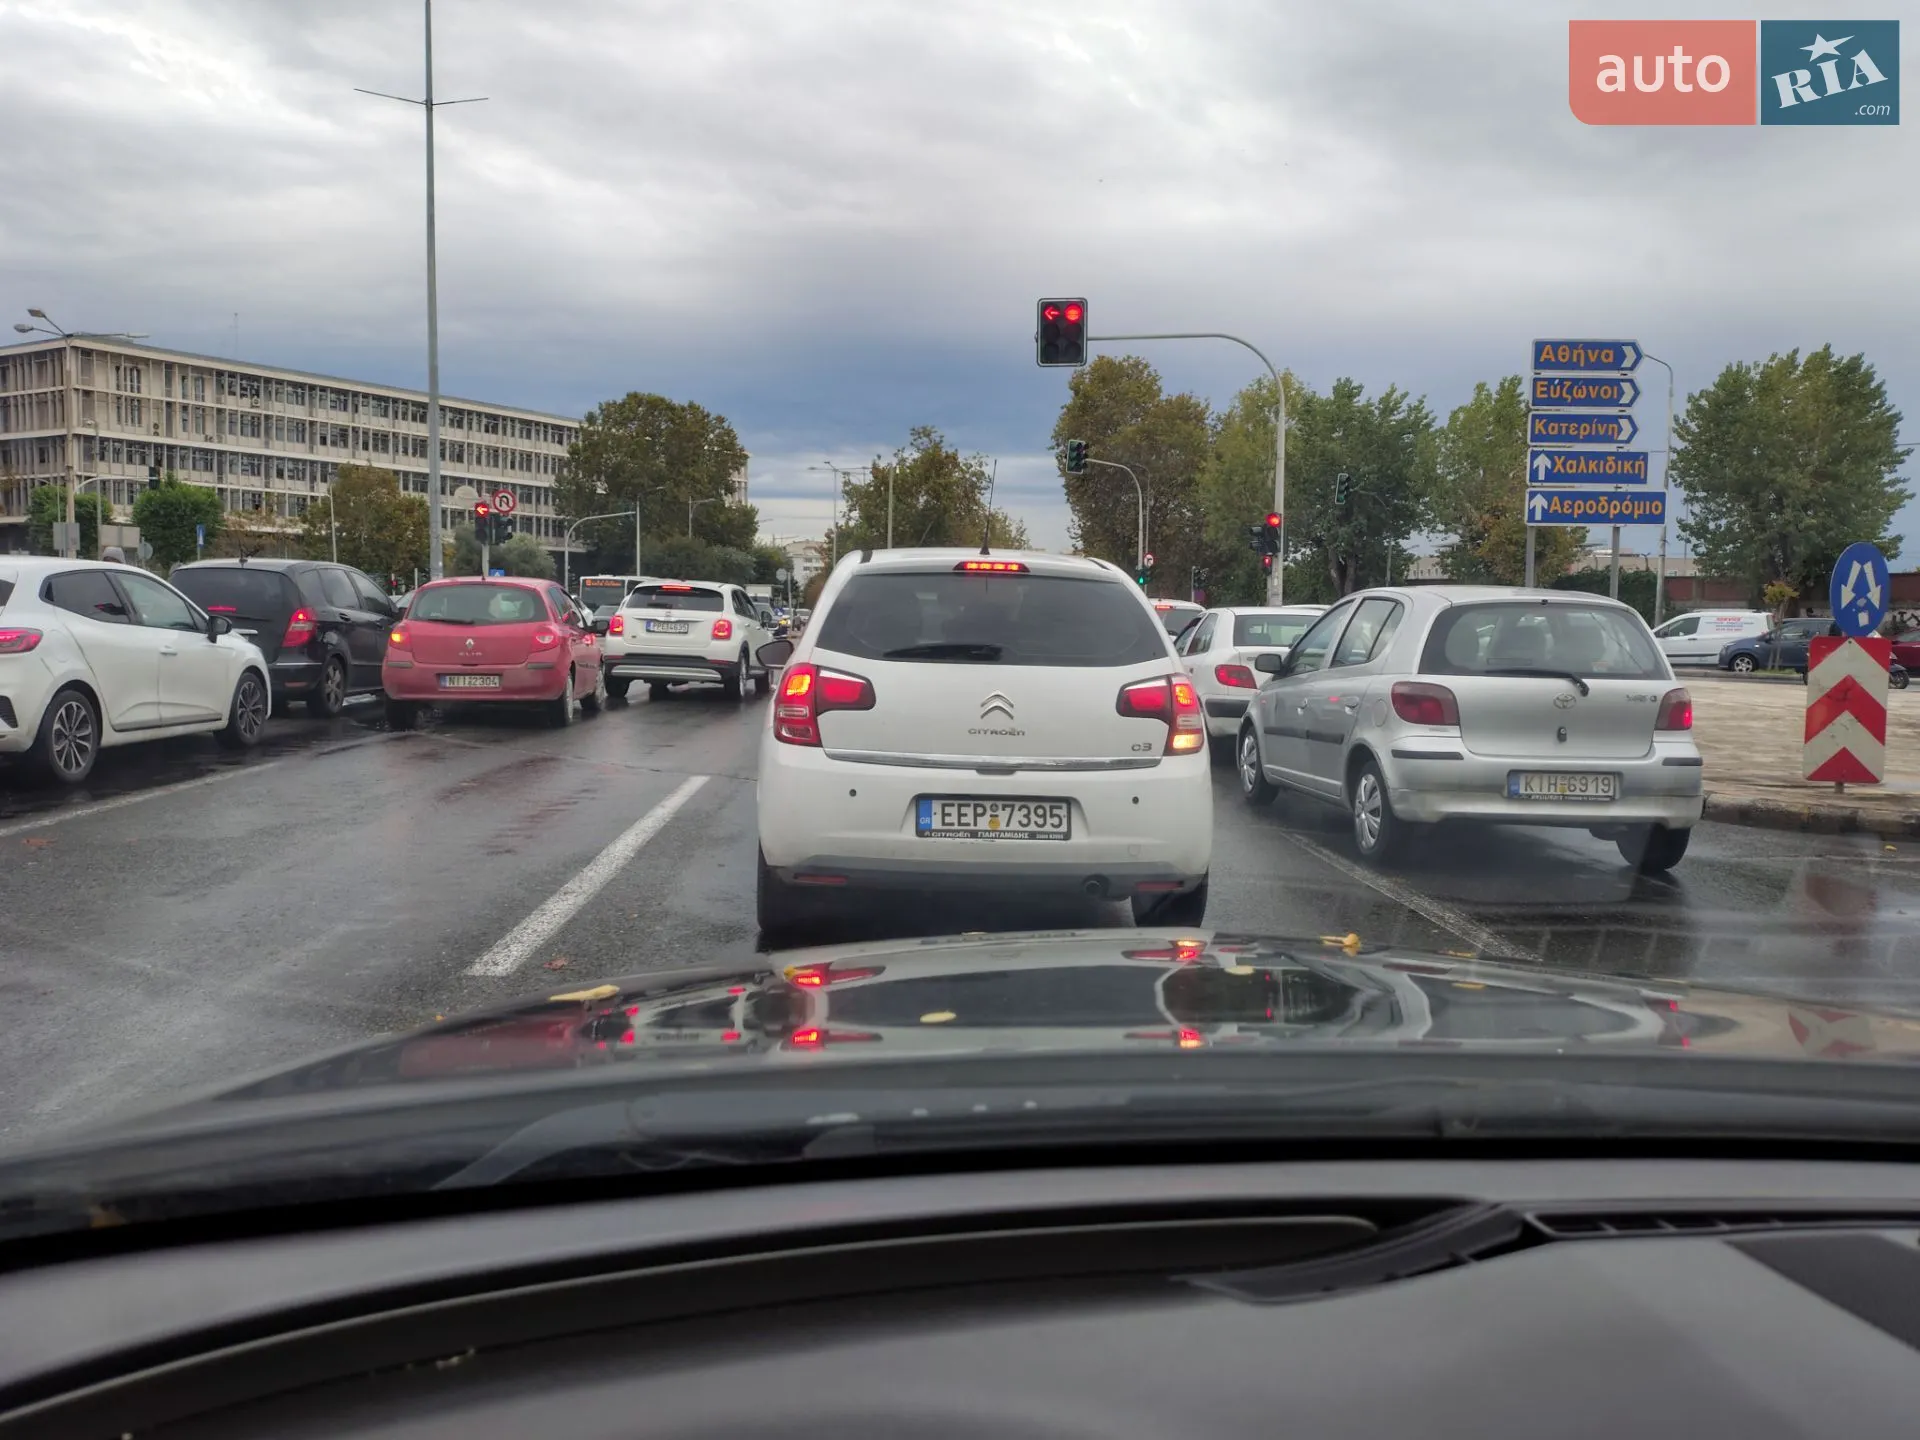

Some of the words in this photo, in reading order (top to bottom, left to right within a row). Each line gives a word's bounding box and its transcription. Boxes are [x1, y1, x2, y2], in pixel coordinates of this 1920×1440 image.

[1539, 344, 1614, 367] Αθήνα
[1534, 418, 1619, 440] Κατερίνη
[1553, 455, 1646, 480] Χαλκιδική
[1549, 495, 1663, 520] Αεροδρόμιο
[1131, 742, 1153, 752] C3
[1567, 776, 1611, 794] 6919
[1001, 803, 1064, 829] 7395
